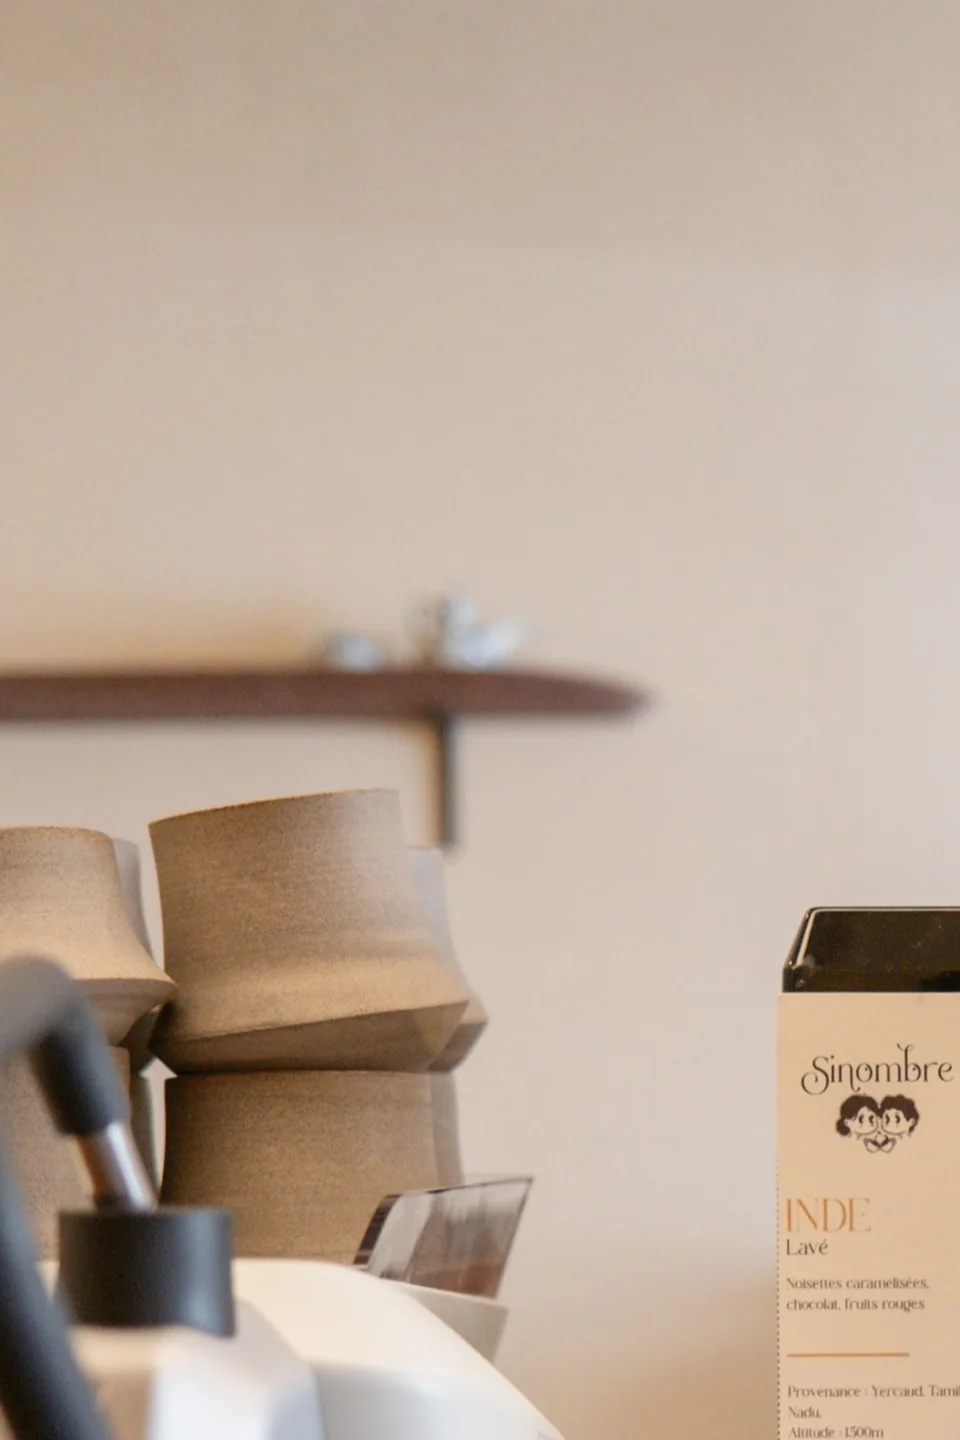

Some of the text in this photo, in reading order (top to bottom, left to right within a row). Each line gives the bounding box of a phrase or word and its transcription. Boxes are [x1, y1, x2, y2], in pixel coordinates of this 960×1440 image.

[801, 1042, 955, 1096] Sinombre
[785, 1197, 872, 1233] INDE
[785, 1238, 829, 1256] Lavé
[786, 1277, 842, 1290] Noisettes
[844, 1297, 878, 1310] fruits
[882, 1299, 925, 1313] rouges
[787, 1384, 861, 1398] Provenance
[788, 1427, 836, 1439] Altitude
[845, 1426, 884, 1439] 1500m
